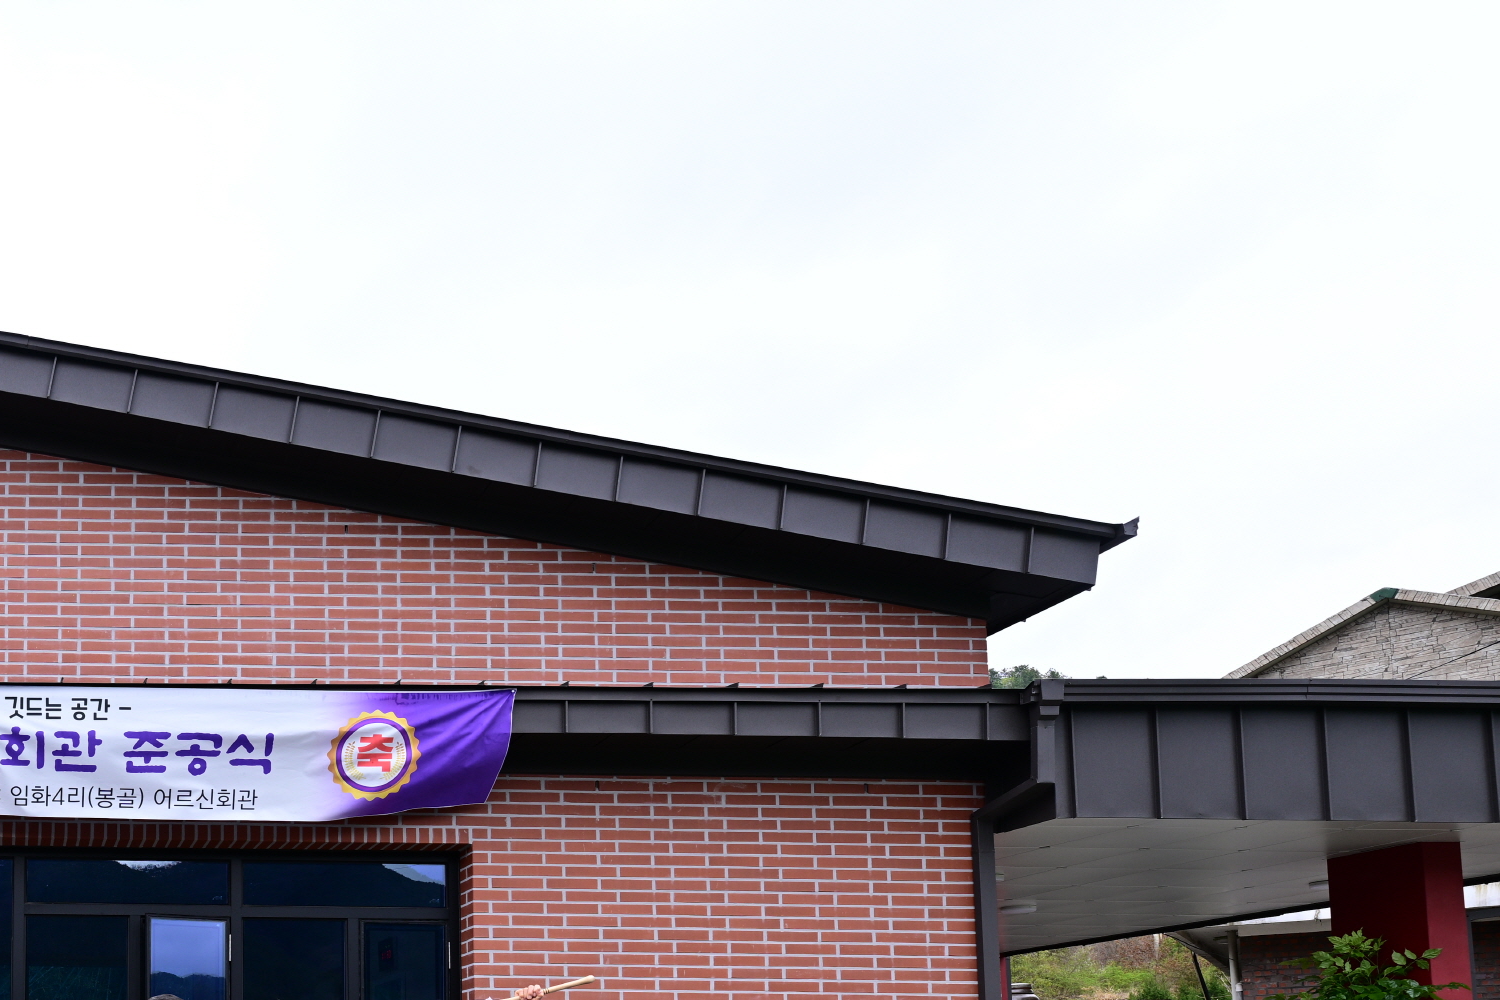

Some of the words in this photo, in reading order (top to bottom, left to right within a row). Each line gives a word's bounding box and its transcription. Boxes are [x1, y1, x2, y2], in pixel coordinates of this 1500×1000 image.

[4, 697, 62, 720] 깃드는
[70, 698, 111, 721] 공간
[123, 731, 275, 777] 준공식
[357, 734, 394, 772] 축
[10, 785, 144, 809] 임화4리(봉골)
[153, 788, 258, 810] 어르신회관
